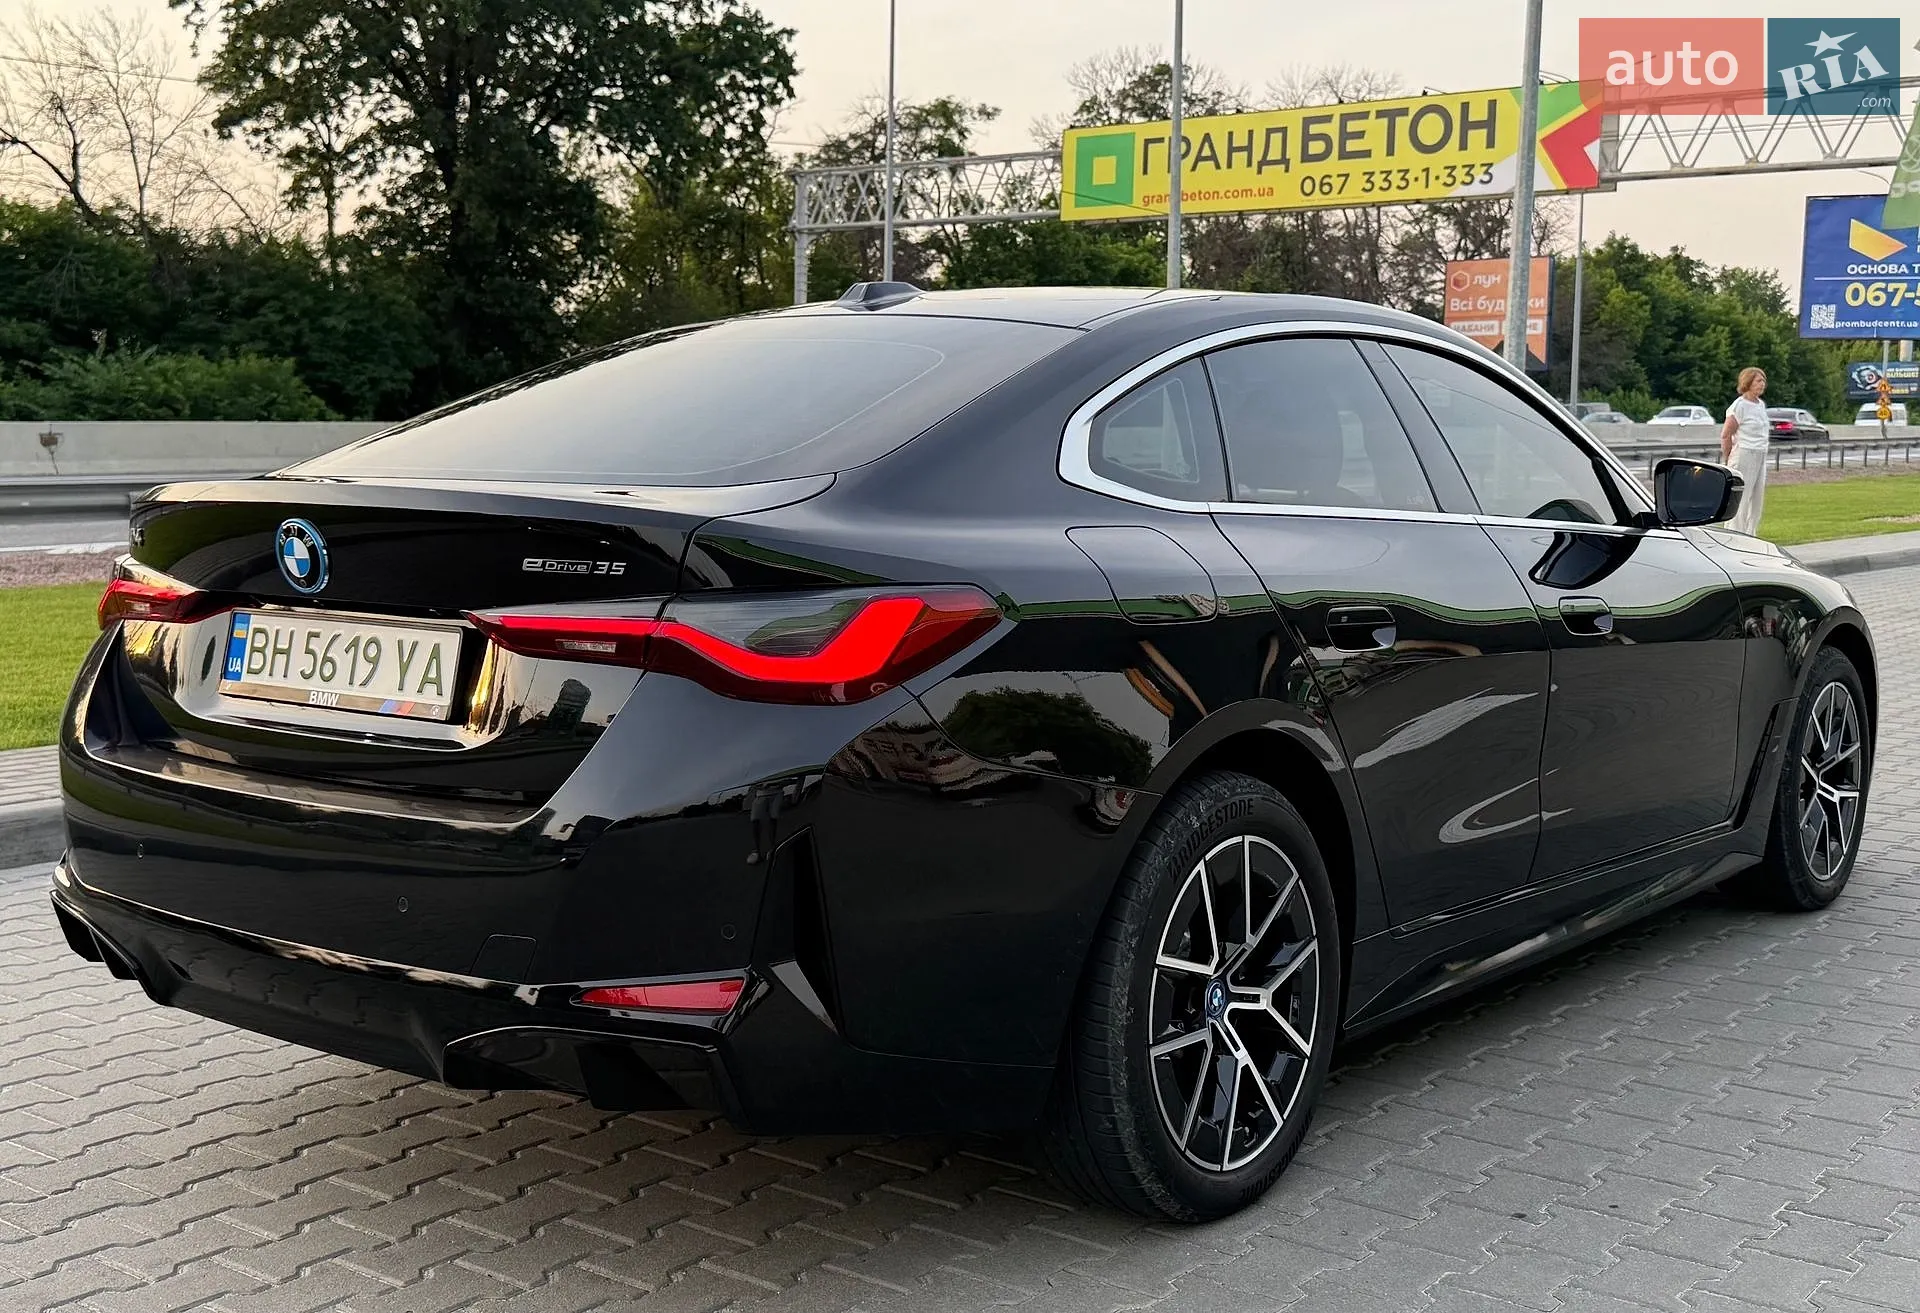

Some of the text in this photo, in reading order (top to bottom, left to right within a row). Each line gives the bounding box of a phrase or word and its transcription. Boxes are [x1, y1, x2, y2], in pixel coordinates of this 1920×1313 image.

[1300, 173, 1350, 197] 067
[1142, 187, 1274, 207] granbeton.com.ua
[1846, 264, 1909, 274] ОСНОВА
[1450, 296, 1544, 313] Всі будки
[1835, 320, 1918, 329] prombudcentr.ua
[228, 656, 242, 672] UA
[246, 626, 443, 696] BH 5619 YA
[308, 691, 340, 707] BMW
